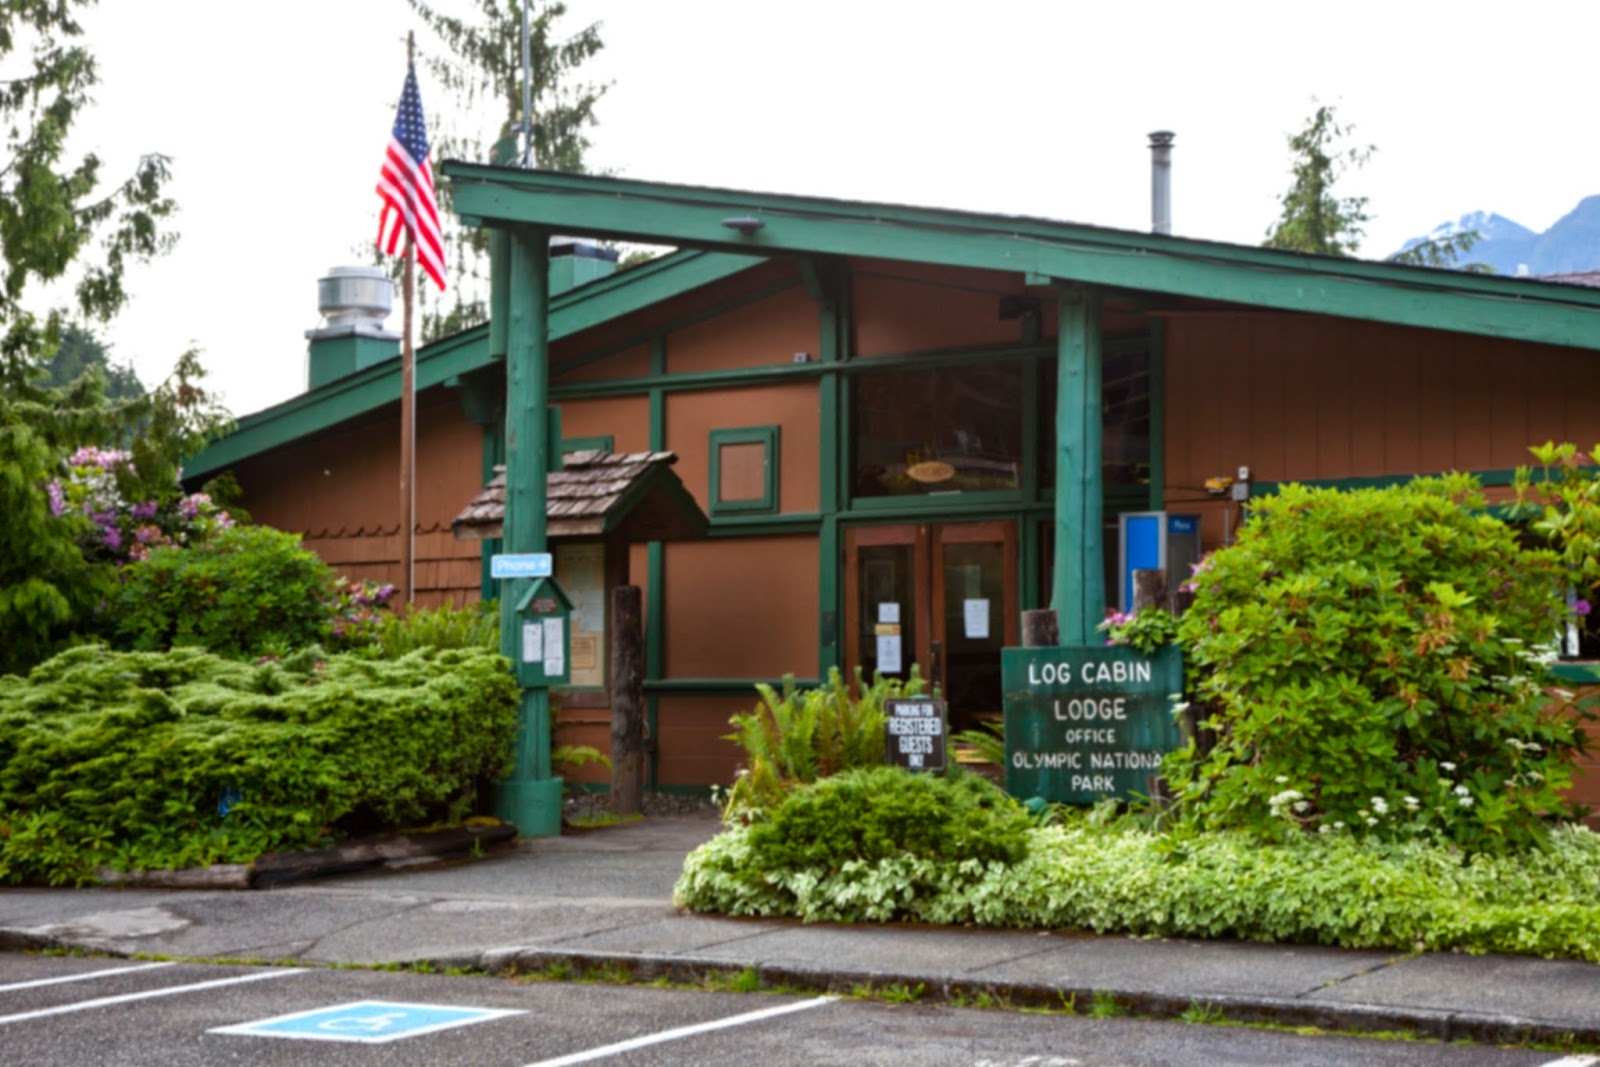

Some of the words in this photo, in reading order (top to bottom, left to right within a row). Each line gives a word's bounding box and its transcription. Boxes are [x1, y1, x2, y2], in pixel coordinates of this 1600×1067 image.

[497, 559, 536, 571] Phone
[1028, 662, 1071, 685] LOG
[1081, 661, 1151, 683] CABIN
[895, 704, 920, 716] PARKING
[921, 704, 934, 716] FOR
[1053, 698, 1127, 720] LODGE
[889, 717, 941, 735] REGISTERED
[899, 736, 933, 754] GUESTS
[1065, 728, 1117, 744] OFFICE
[909, 754, 924, 768] ONLY
[1012, 751, 1082, 769] OLYMPIC
[1090, 751, 1163, 769] NATIONA
[1071, 774, 1116, 793] PARK
